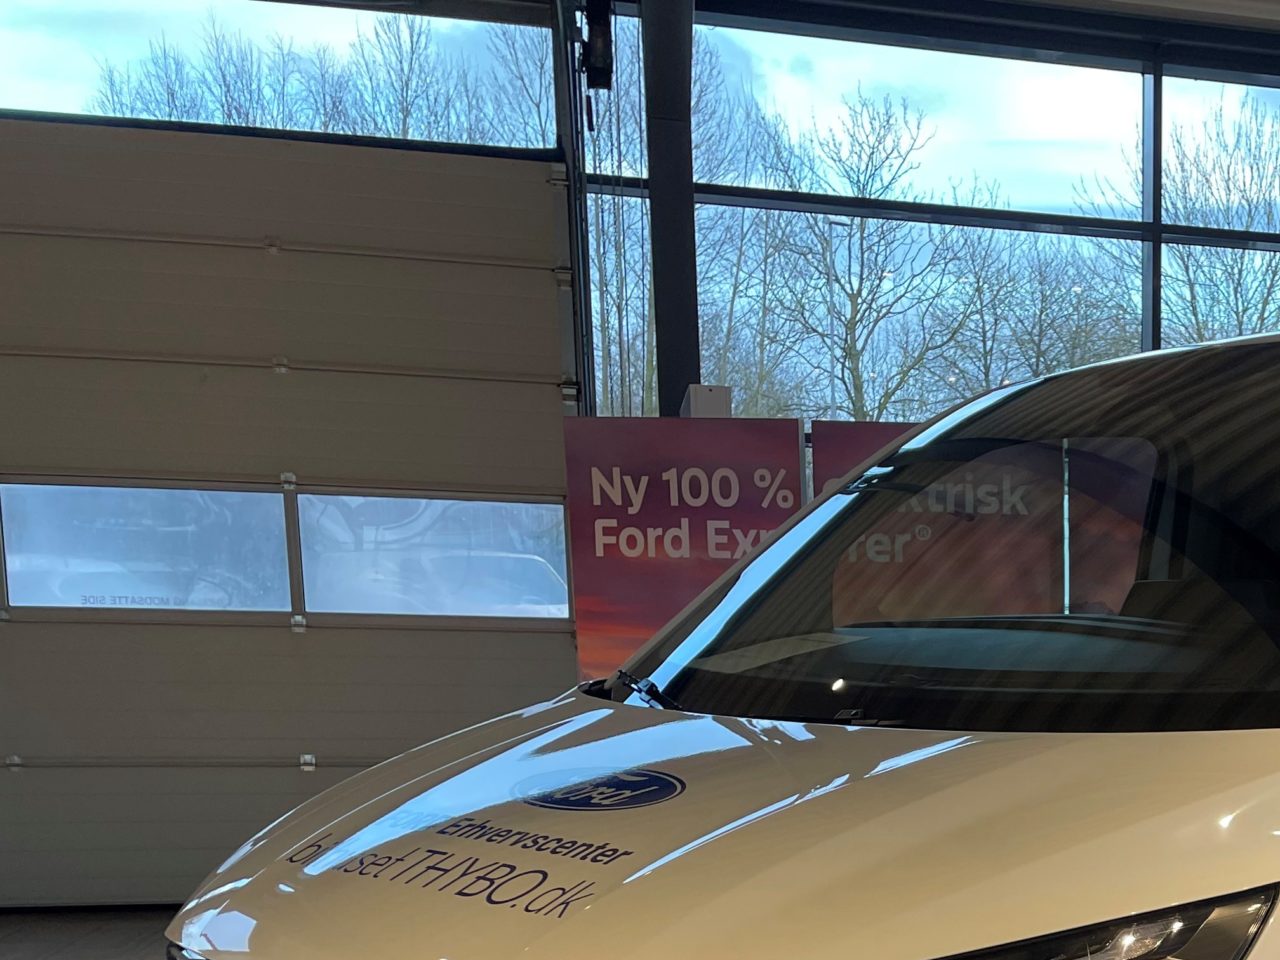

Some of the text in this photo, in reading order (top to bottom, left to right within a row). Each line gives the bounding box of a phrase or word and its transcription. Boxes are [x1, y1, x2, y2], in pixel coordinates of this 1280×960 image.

[591, 467, 1028, 516] Ny 100 % ktrisk
[594, 517, 690, 558] Ford
[436, 817, 635, 865] Erhvervscenter
[286, 832, 600, 918] bilusetTHYBO.dk
